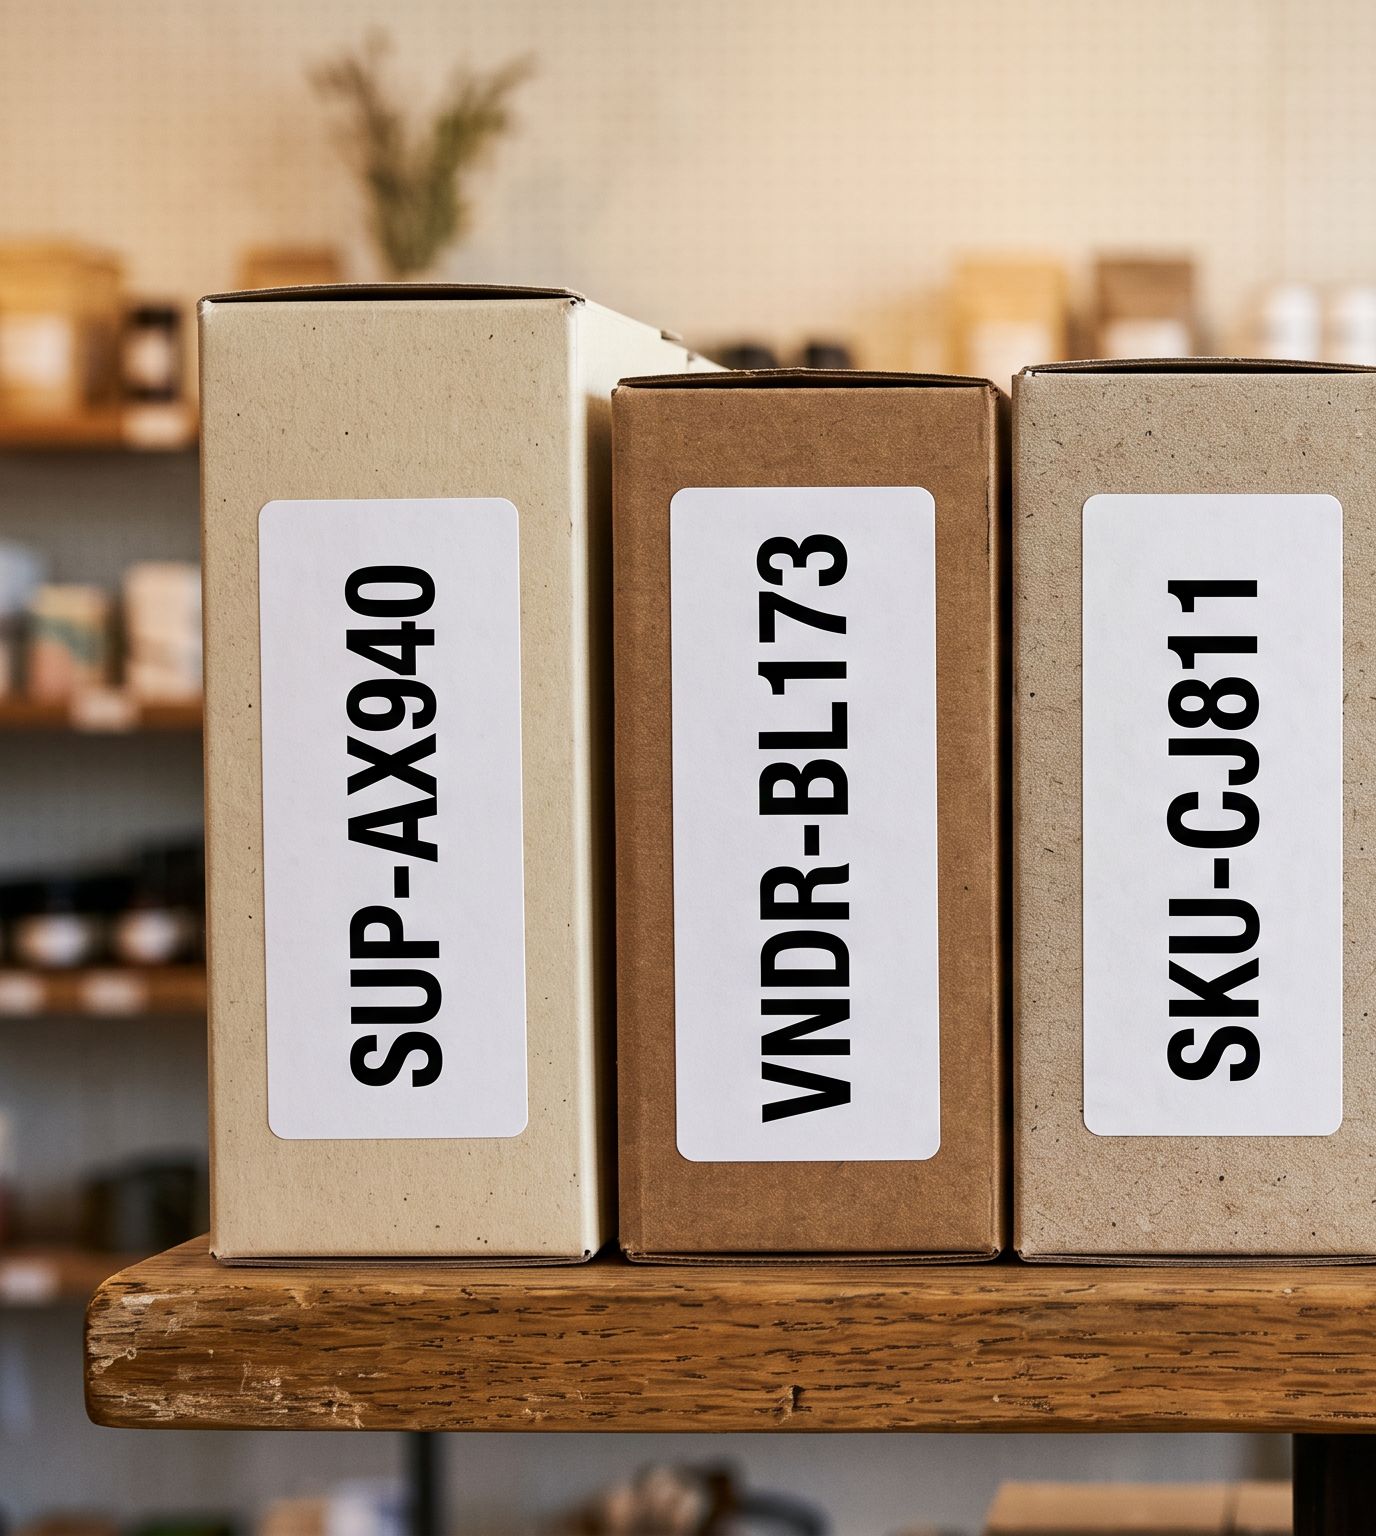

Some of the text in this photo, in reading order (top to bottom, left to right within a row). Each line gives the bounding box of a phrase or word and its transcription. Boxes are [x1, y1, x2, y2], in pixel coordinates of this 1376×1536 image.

[345, 565, 443, 1088] SUP-AX940
[756, 533, 851, 1124] VNDR-BL173
[1166, 579, 1261, 1082] SKU-CJ811
